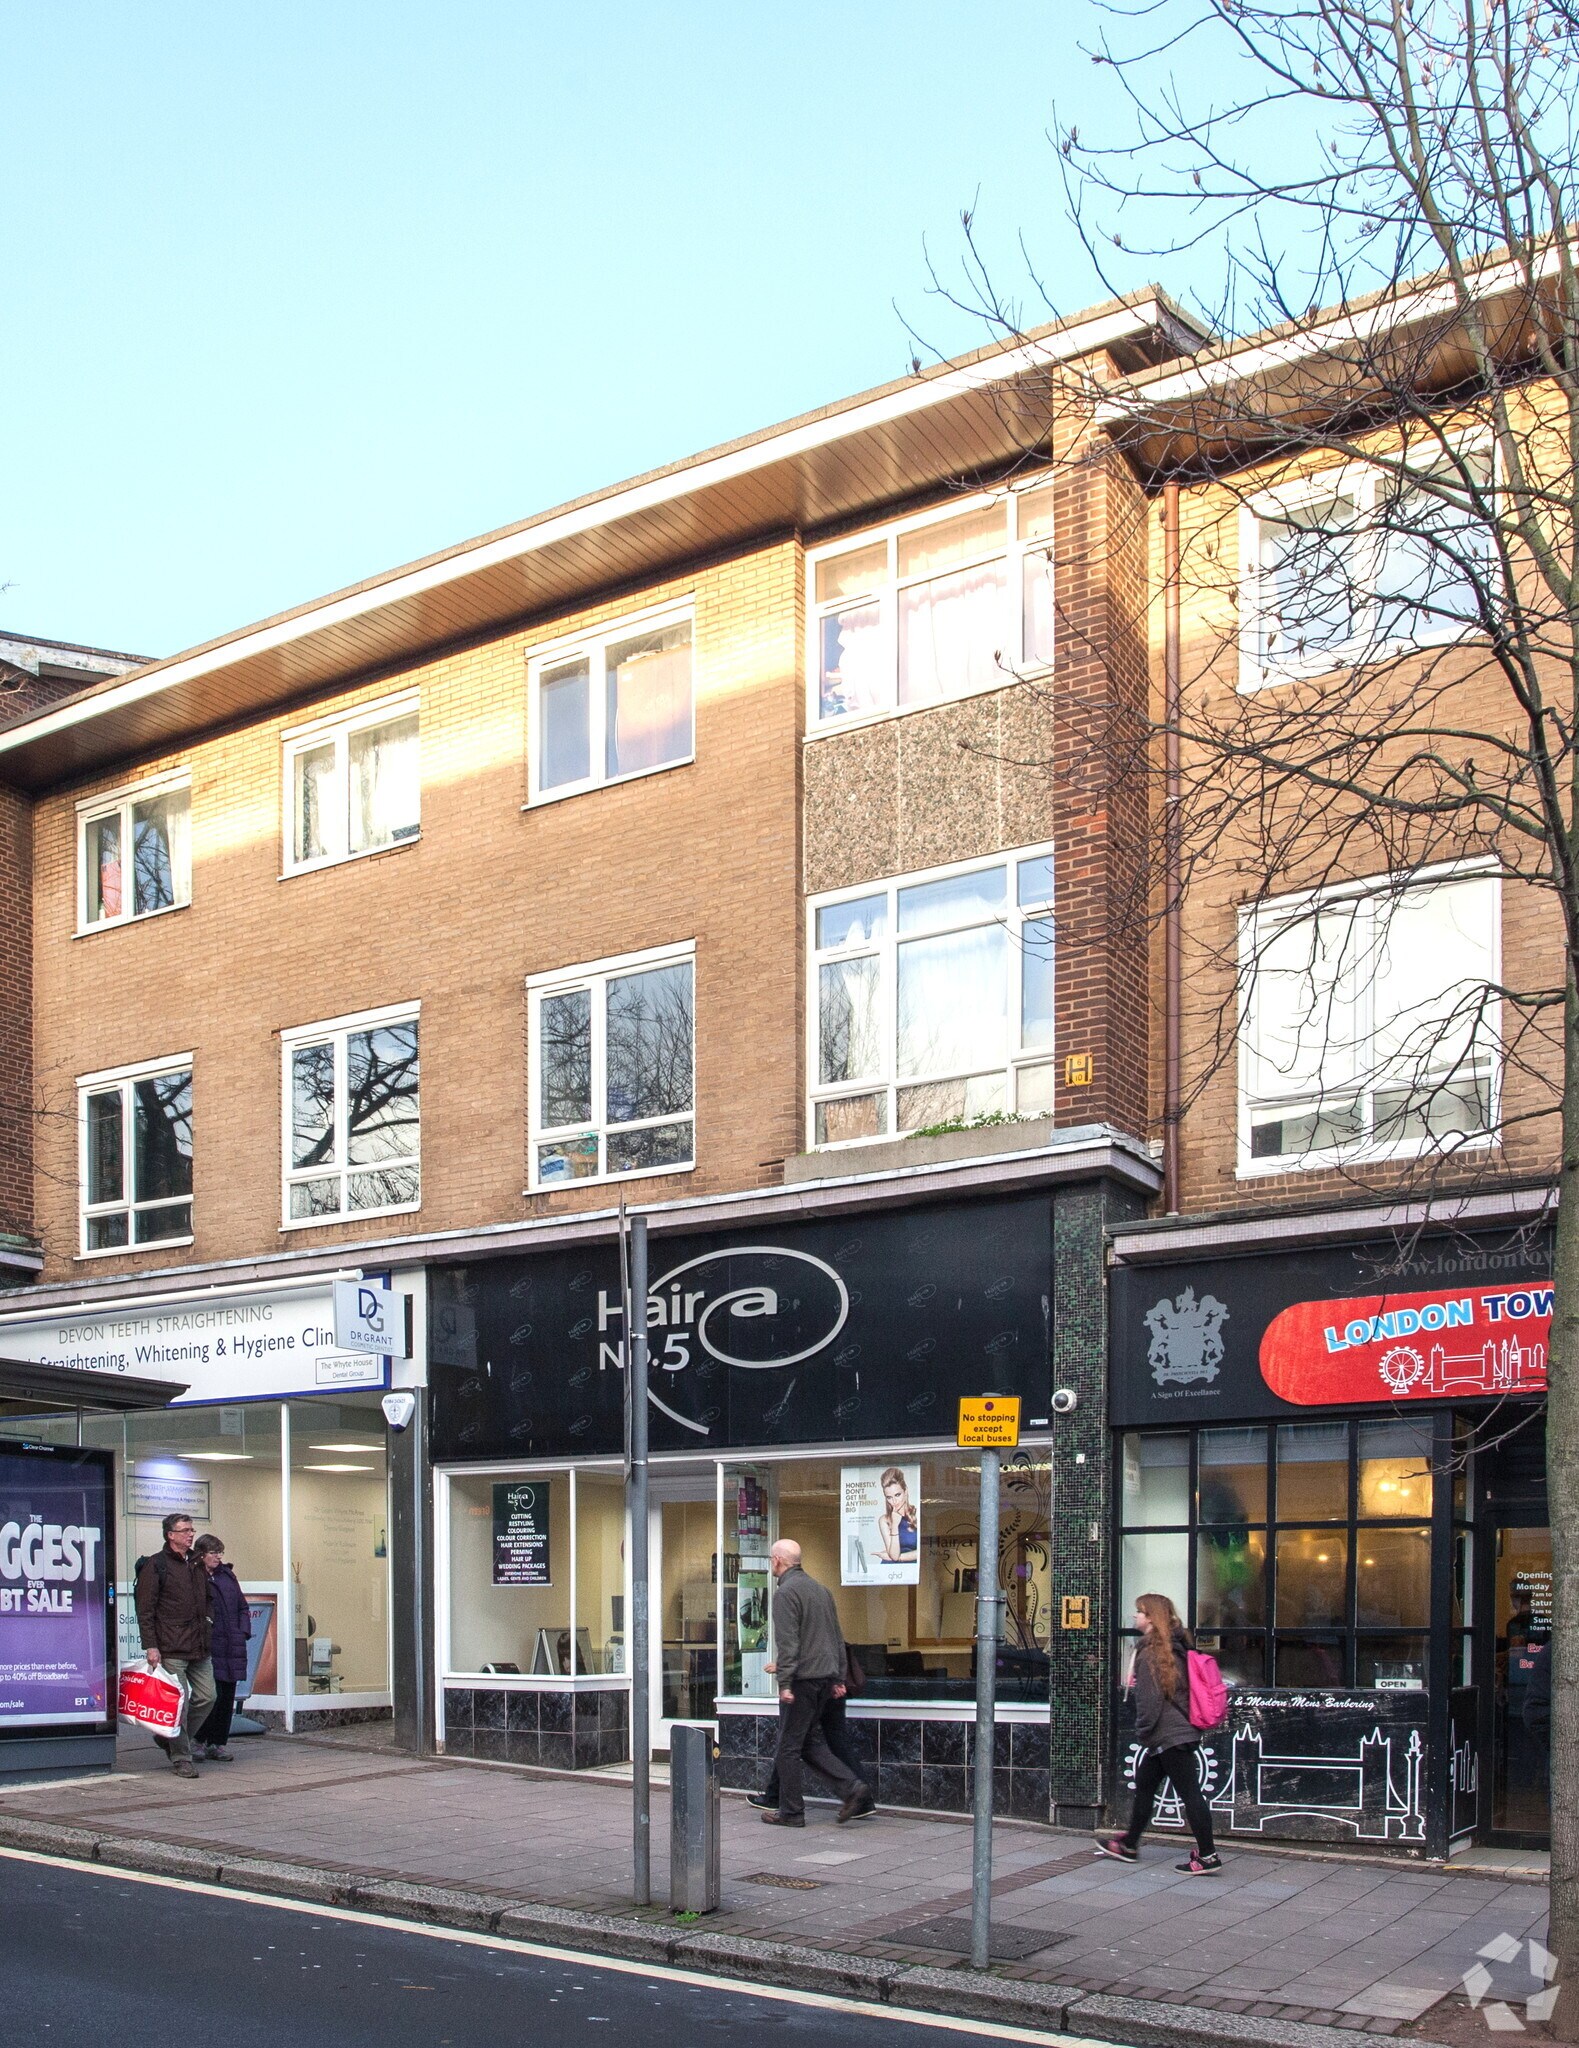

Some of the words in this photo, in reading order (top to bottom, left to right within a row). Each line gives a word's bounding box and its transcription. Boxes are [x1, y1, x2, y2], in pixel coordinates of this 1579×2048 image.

[1076, 1058, 1083, 1066] 6
[1075, 1073, 1083, 1082] 10
[598, 1283, 704, 1331] Hair
[59, 1325, 104, 1344] DEVON
[109, 1319, 150, 1338] TEETH
[156, 1304, 273, 1333] STRAIGHTENING
[1323, 1298, 1474, 1353] LONDON
[350, 1330, 362, 1341] DR
[364, 1332, 393, 1345] GRANT
[135, 1342, 210, 1363] Whitening
[216, 1338, 226, 1356] &
[233, 1333, 295, 1359] Hygiene
[600, 1332, 690, 1371] N.5
[321, 1362, 331, 1370] The
[333, 1360, 352, 1369] Whyte
[353, 1358, 373, 1366] House
[349, 1370, 364, 1378] Group
[1157, 1391, 1173, 1399] Sign
[1174, 1390, 1183, 1398] Of
[962, 1414, 975, 1422] No
[978, 1413, 1015, 1423] stopping
[973, 1425, 1003, 1433] except
[987, 1434, 1012, 1442] buses
[846, 1481, 877, 1489] HONESTLY,
[29, 1514, 42, 1523] THE
[930, 1536, 958, 1548] Hair
[888, 1572, 902, 1582] ghd
[1516, 1571, 1552, 1580] Opening
[27, 1580, 44, 1589] EVER
[1516, 1583, 1550, 1591] Monday
[0, 1588, 24, 1612] BT
[27, 1588, 73, 1613] SALE
[1066, 1598, 1086, 1625] H
[13, 1662, 30, 1671] prices
[31, 1662, 44, 1670] than
[57, 1661, 78, 1671] before,
[12, 1672, 27, 1681] 40%
[28, 1672, 37, 1680] off
[37, 1672, 70, 1681] Broadband.
[1380, 1680, 1407, 1688] OPEN
[74, 1697, 88, 1706] BT
[1234, 1695, 1243, 1706] &
[1244, 1696, 1288, 1707] Modern
[1290, 1696, 1320, 1708] Mens
[1325, 1697, 1376, 1711] Barbering
